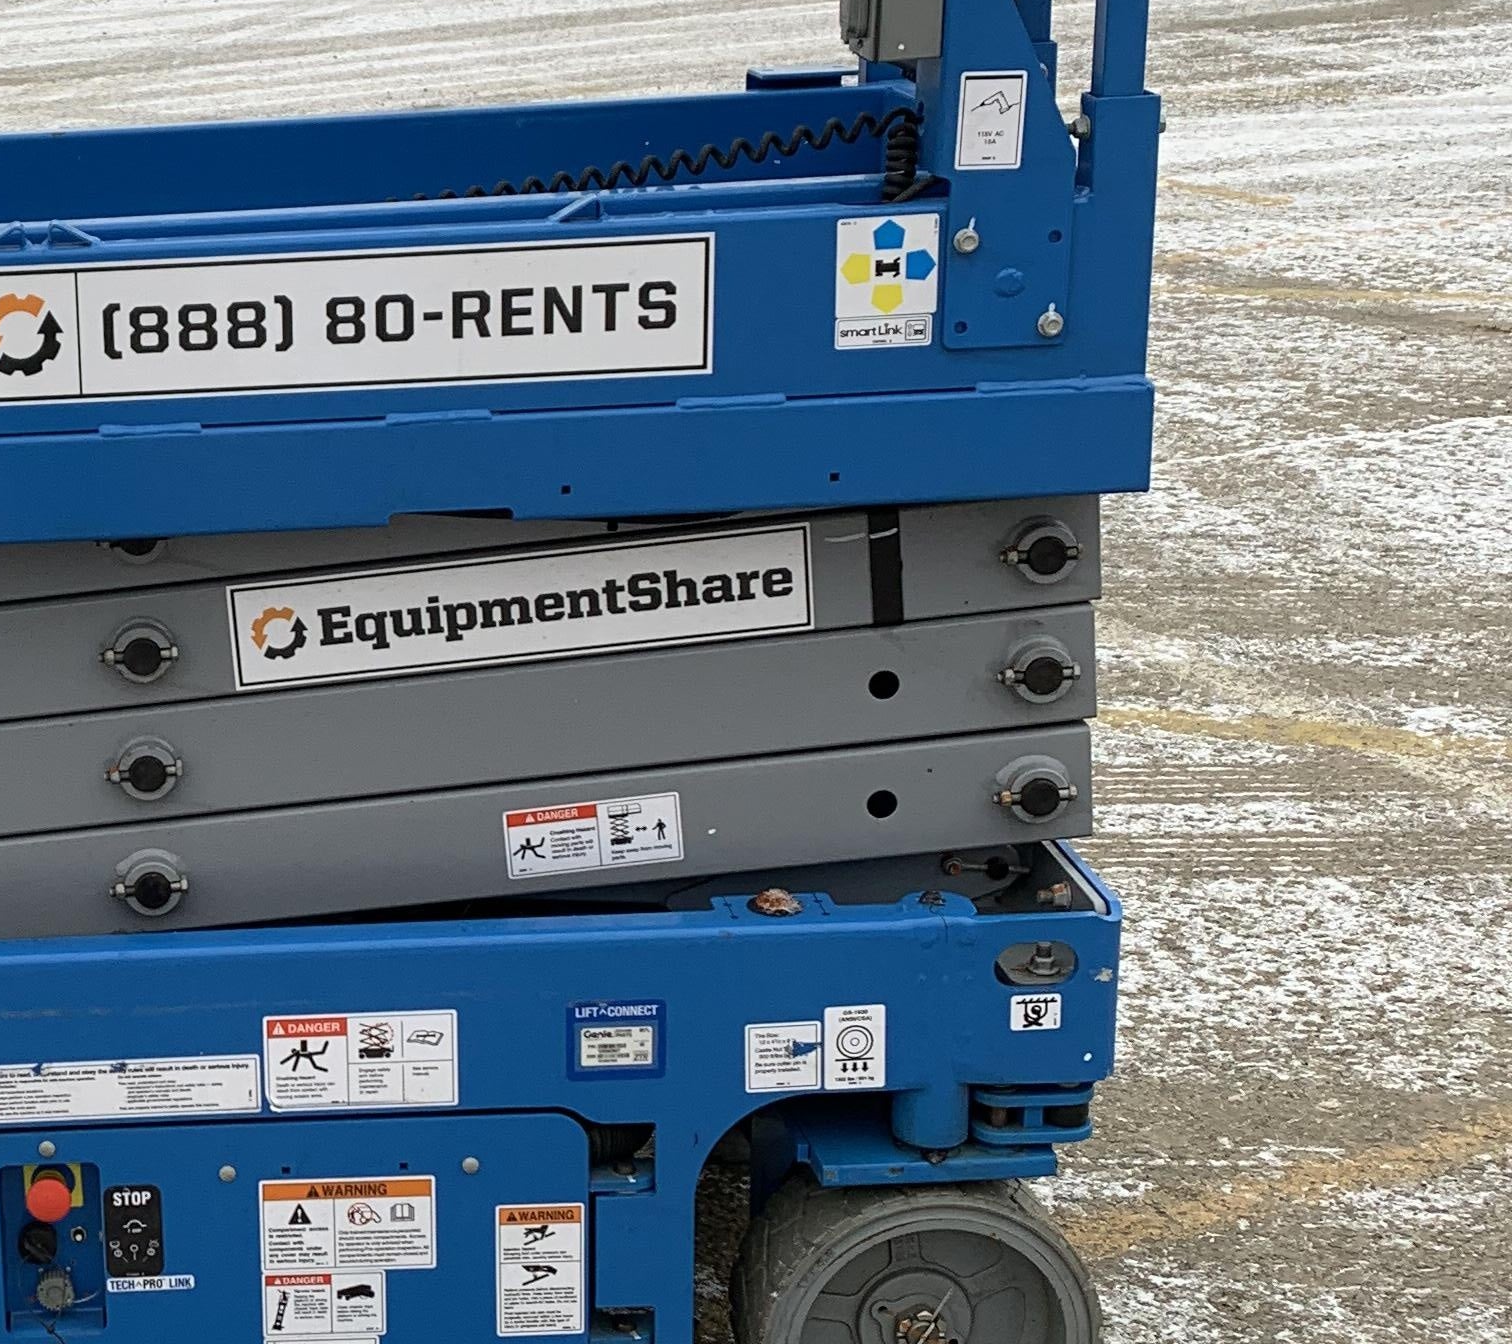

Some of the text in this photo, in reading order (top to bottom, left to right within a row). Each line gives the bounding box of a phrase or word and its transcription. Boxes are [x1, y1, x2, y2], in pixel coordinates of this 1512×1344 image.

[102, 280, 677, 360] (888) 80-RENTS
[317, 566, 794, 651] EquipmentShare
[538, 808, 579, 821] DANGER
[575, 1005, 658, 1018] LIFT CONNECT
[288, 1023, 340, 1033] DANGER
[322, 1184, 387, 1196] WARNING
[113, 1191, 151, 1206] STOP
[519, 1210, 574, 1221] WARNING
[110, 1280, 135, 1290] TECH
[169, 1277, 191, 1288] LINK
[283, 1276, 324, 1284] DANGER
